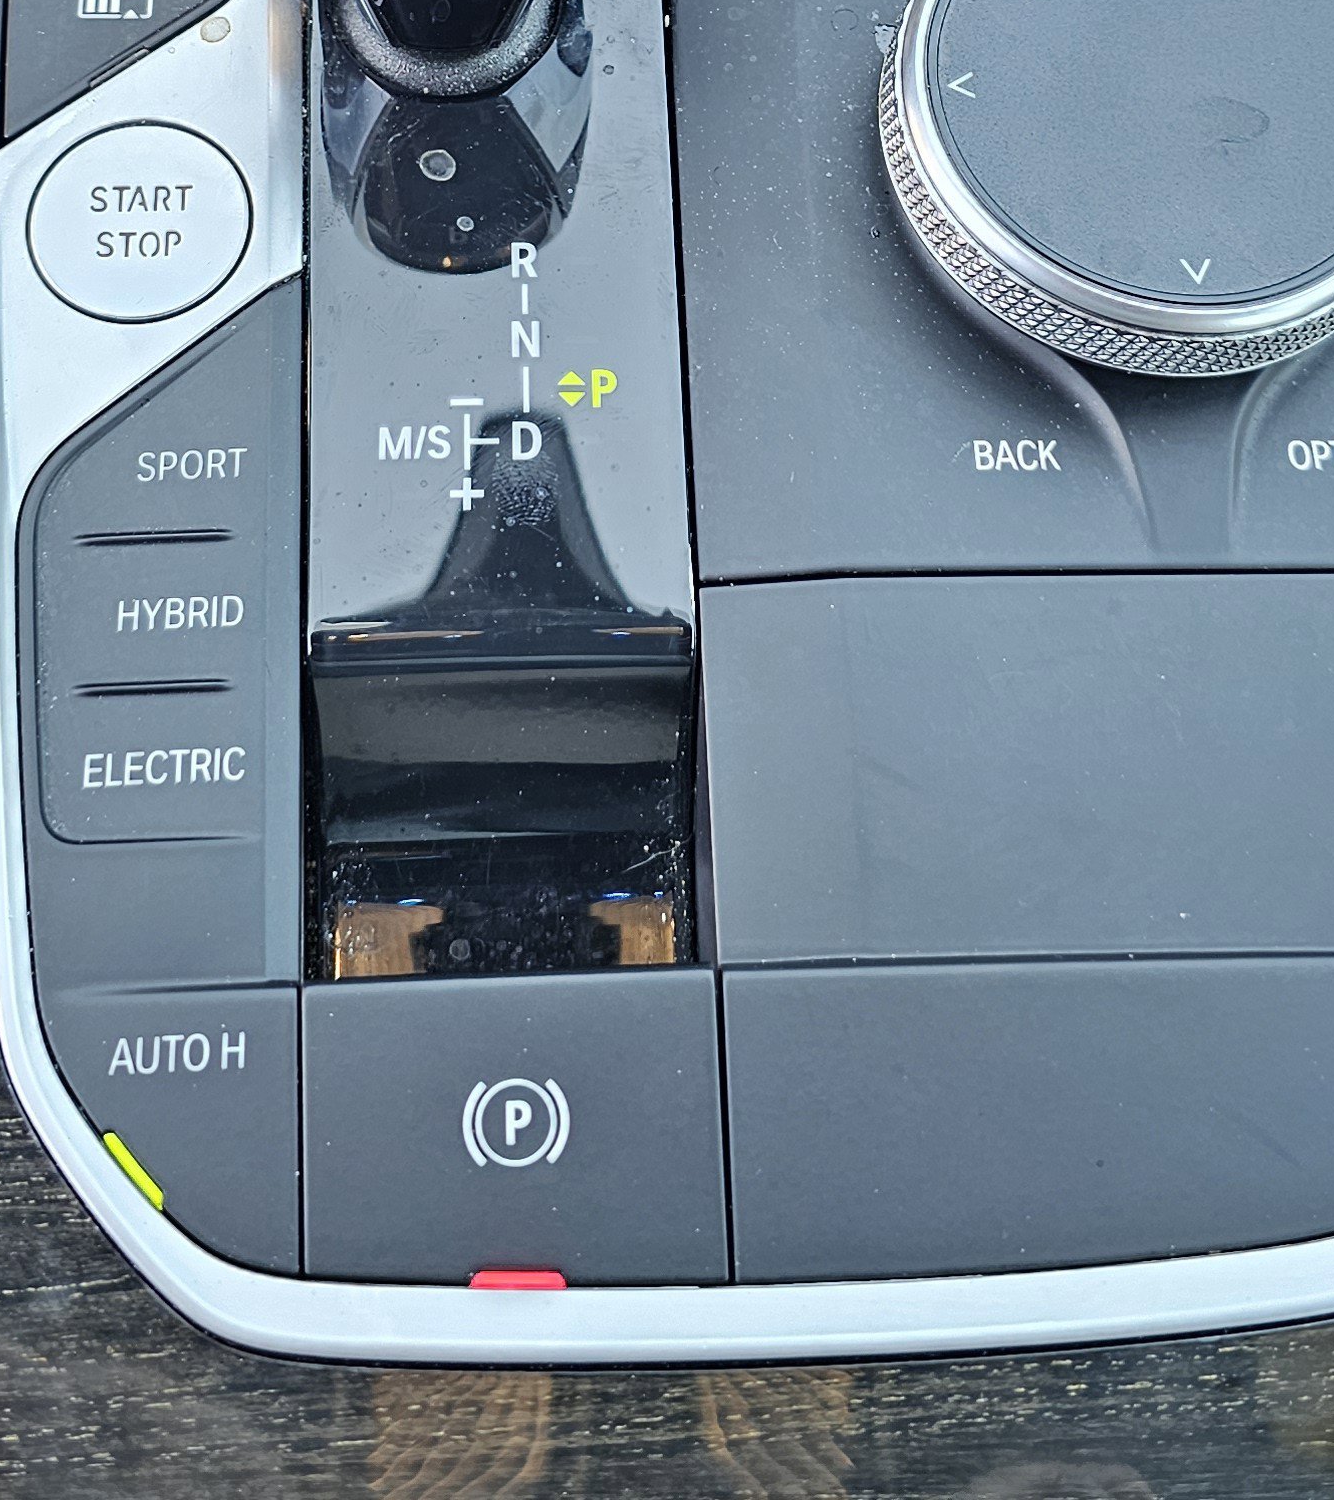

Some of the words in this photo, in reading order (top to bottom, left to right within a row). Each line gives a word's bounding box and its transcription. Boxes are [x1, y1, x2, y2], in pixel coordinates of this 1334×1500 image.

[89, 184, 194, 214] START
[95, 230, 183, 259] STOP
[510, 240, 539, 279] R
[510, 320, 541, 358] N
[591, 368, 619, 409] P
[377, 424, 453, 461] M/S
[511, 420, 544, 461] D
[972, 439, 1062, 473] BACK
[136, 446, 248, 484] SPORT
[116, 594, 246, 633] HYBRID
[80, 745, 247, 791] ELECTRIC
[108, 1032, 211, 1078] AUTO
[220, 1030, 246, 1071] H
[504, 1099, 533, 1147] P
